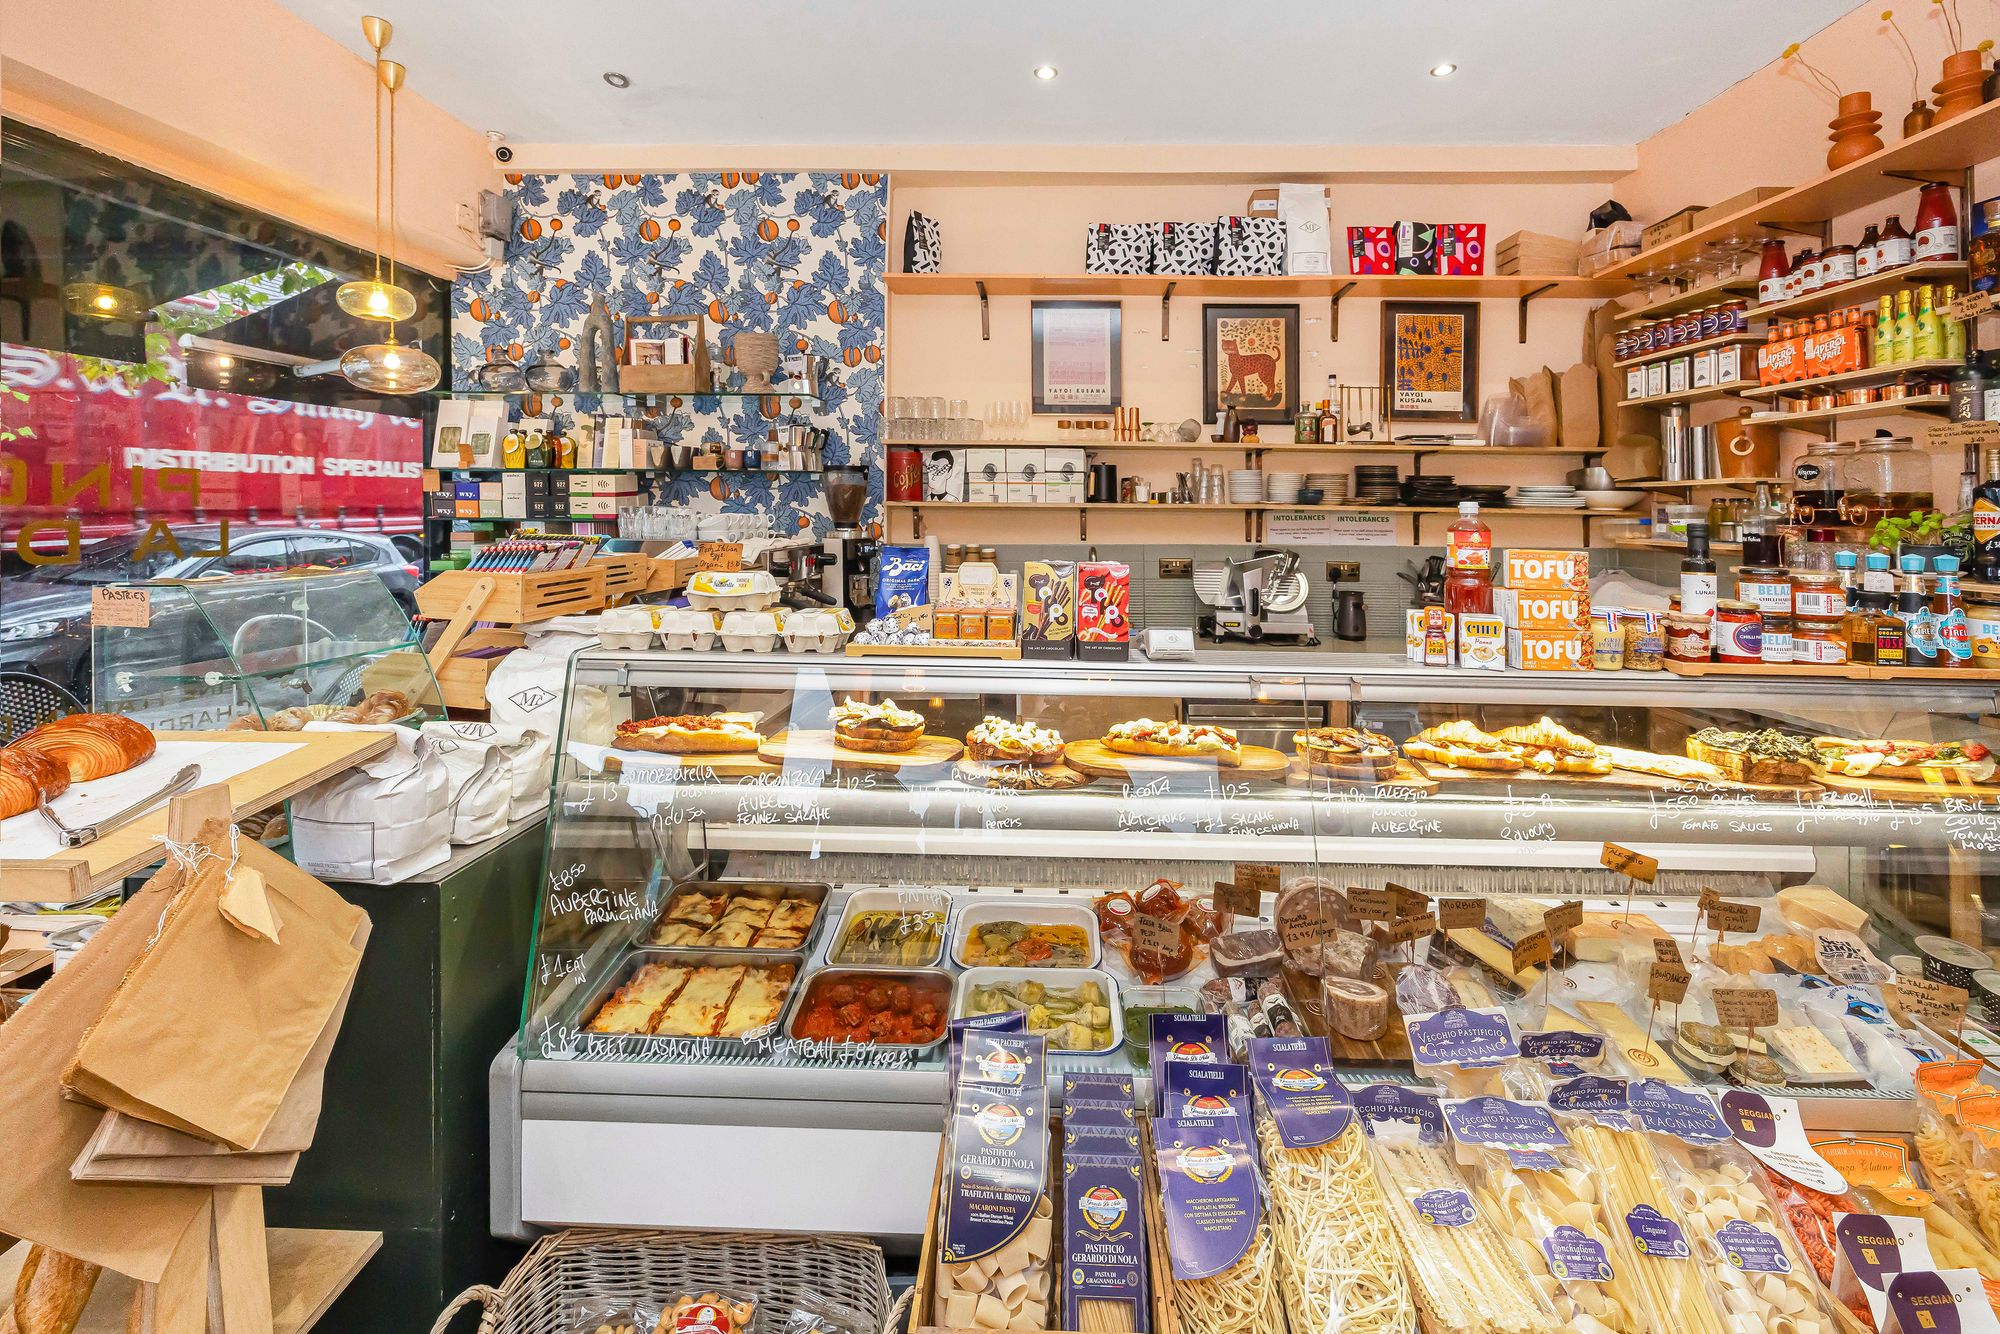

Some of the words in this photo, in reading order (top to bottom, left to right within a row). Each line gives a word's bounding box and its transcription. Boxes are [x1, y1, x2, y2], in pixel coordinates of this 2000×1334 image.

[1814, 336, 1847, 356] APEROL
[1767, 347, 1797, 365] APEROL
[1819, 347, 1842, 363] SPRITZ
[1771, 357, 1792, 371] SPRITZ
[124, 447, 315, 475] DISTRIBUTION
[323, 457, 422, 479] SPECIALIS
[459, 490, 476, 498] wxy.
[459, 507, 476, 516] wxy.
[882, 556, 924, 577] Baci
[1510, 559, 1574, 581] TOFU
[1519, 599, 1579, 620] TOFU
[1466, 623, 1501, 635] CHEF
[1523, 640, 1582, 660] TOFU
[636, 764, 721, 785] mozzarella
[736, 810, 781, 826] FENNEL
[1231, 810, 1275, 826] SALAME
[1729, 820, 1773, 832] SAUCE
[1440, 900, 1483, 910] MORBIER
[574, 975, 587, 985] IN
[1417, 1029, 1457, 1044] VECCHIO
[1458, 1028, 1504, 1038] PASTIFICIO
[1558, 1038, 1596, 1048] PASTIFICIO
[588, 1034, 630, 1058] BEEF
[642, 1034, 710, 1063] LASAGNA
[1424, 1041, 1506, 1061] GRAGNANO
[1188, 1069, 1225, 1080] SCIALATIELLI
[1557, 1088, 1586, 1099] VECCHIO
[1586, 1087, 1621, 1096] PASTIFICIO
[1558, 1097, 1619, 1110] GRAGNANO
[1661, 1101, 1710, 1117] PASTIFICIO
[1387, 1104, 1435, 1119] PASTIFICIO
[1738, 1108, 1781, 1122] SEGGIANO
[1176, 1119, 1215, 1128] SCIALATIELLI
[1455, 1114, 1498, 1126] VECCHIO
[1498, 1115, 1549, 1128] PASTIFICIO
[1465, 1124, 1554, 1141] GRAGNANO
[980, 1147, 1017, 1158] PASTIFICIO
[1874, 1148, 1899, 1160] PASTA
[960, 1154, 1000, 1167] GERARDO
[1001, 1157, 1011, 1167] DI
[1011, 1158, 1035, 1170] NOLA
[960, 1188, 994, 1198] TRAFILATA
[1004, 1192, 1031, 1203] BRONZO
[969, 1203, 999, 1213] MACARONI
[1000, 1205, 1017, 1214] PASTA
[1421, 1198, 1459, 1210] Mafaldine
[1641, 1224, 1668, 1236] Linguine
[1856, 1235, 1905, 1246] SEGGIANO
[1085, 1243, 1125, 1254] PASTIFICIO
[1552, 1243, 1596, 1255] Conchiglioni
[1072, 1253, 1108, 1264] GERARDO
[1108, 1254, 1117, 1264] DI
[1117, 1255, 1138, 1265] NOLA
[1086, 1277, 1113, 1285] GRAGNANO
[1911, 1293, 1963, 1307] SEGGIANO
